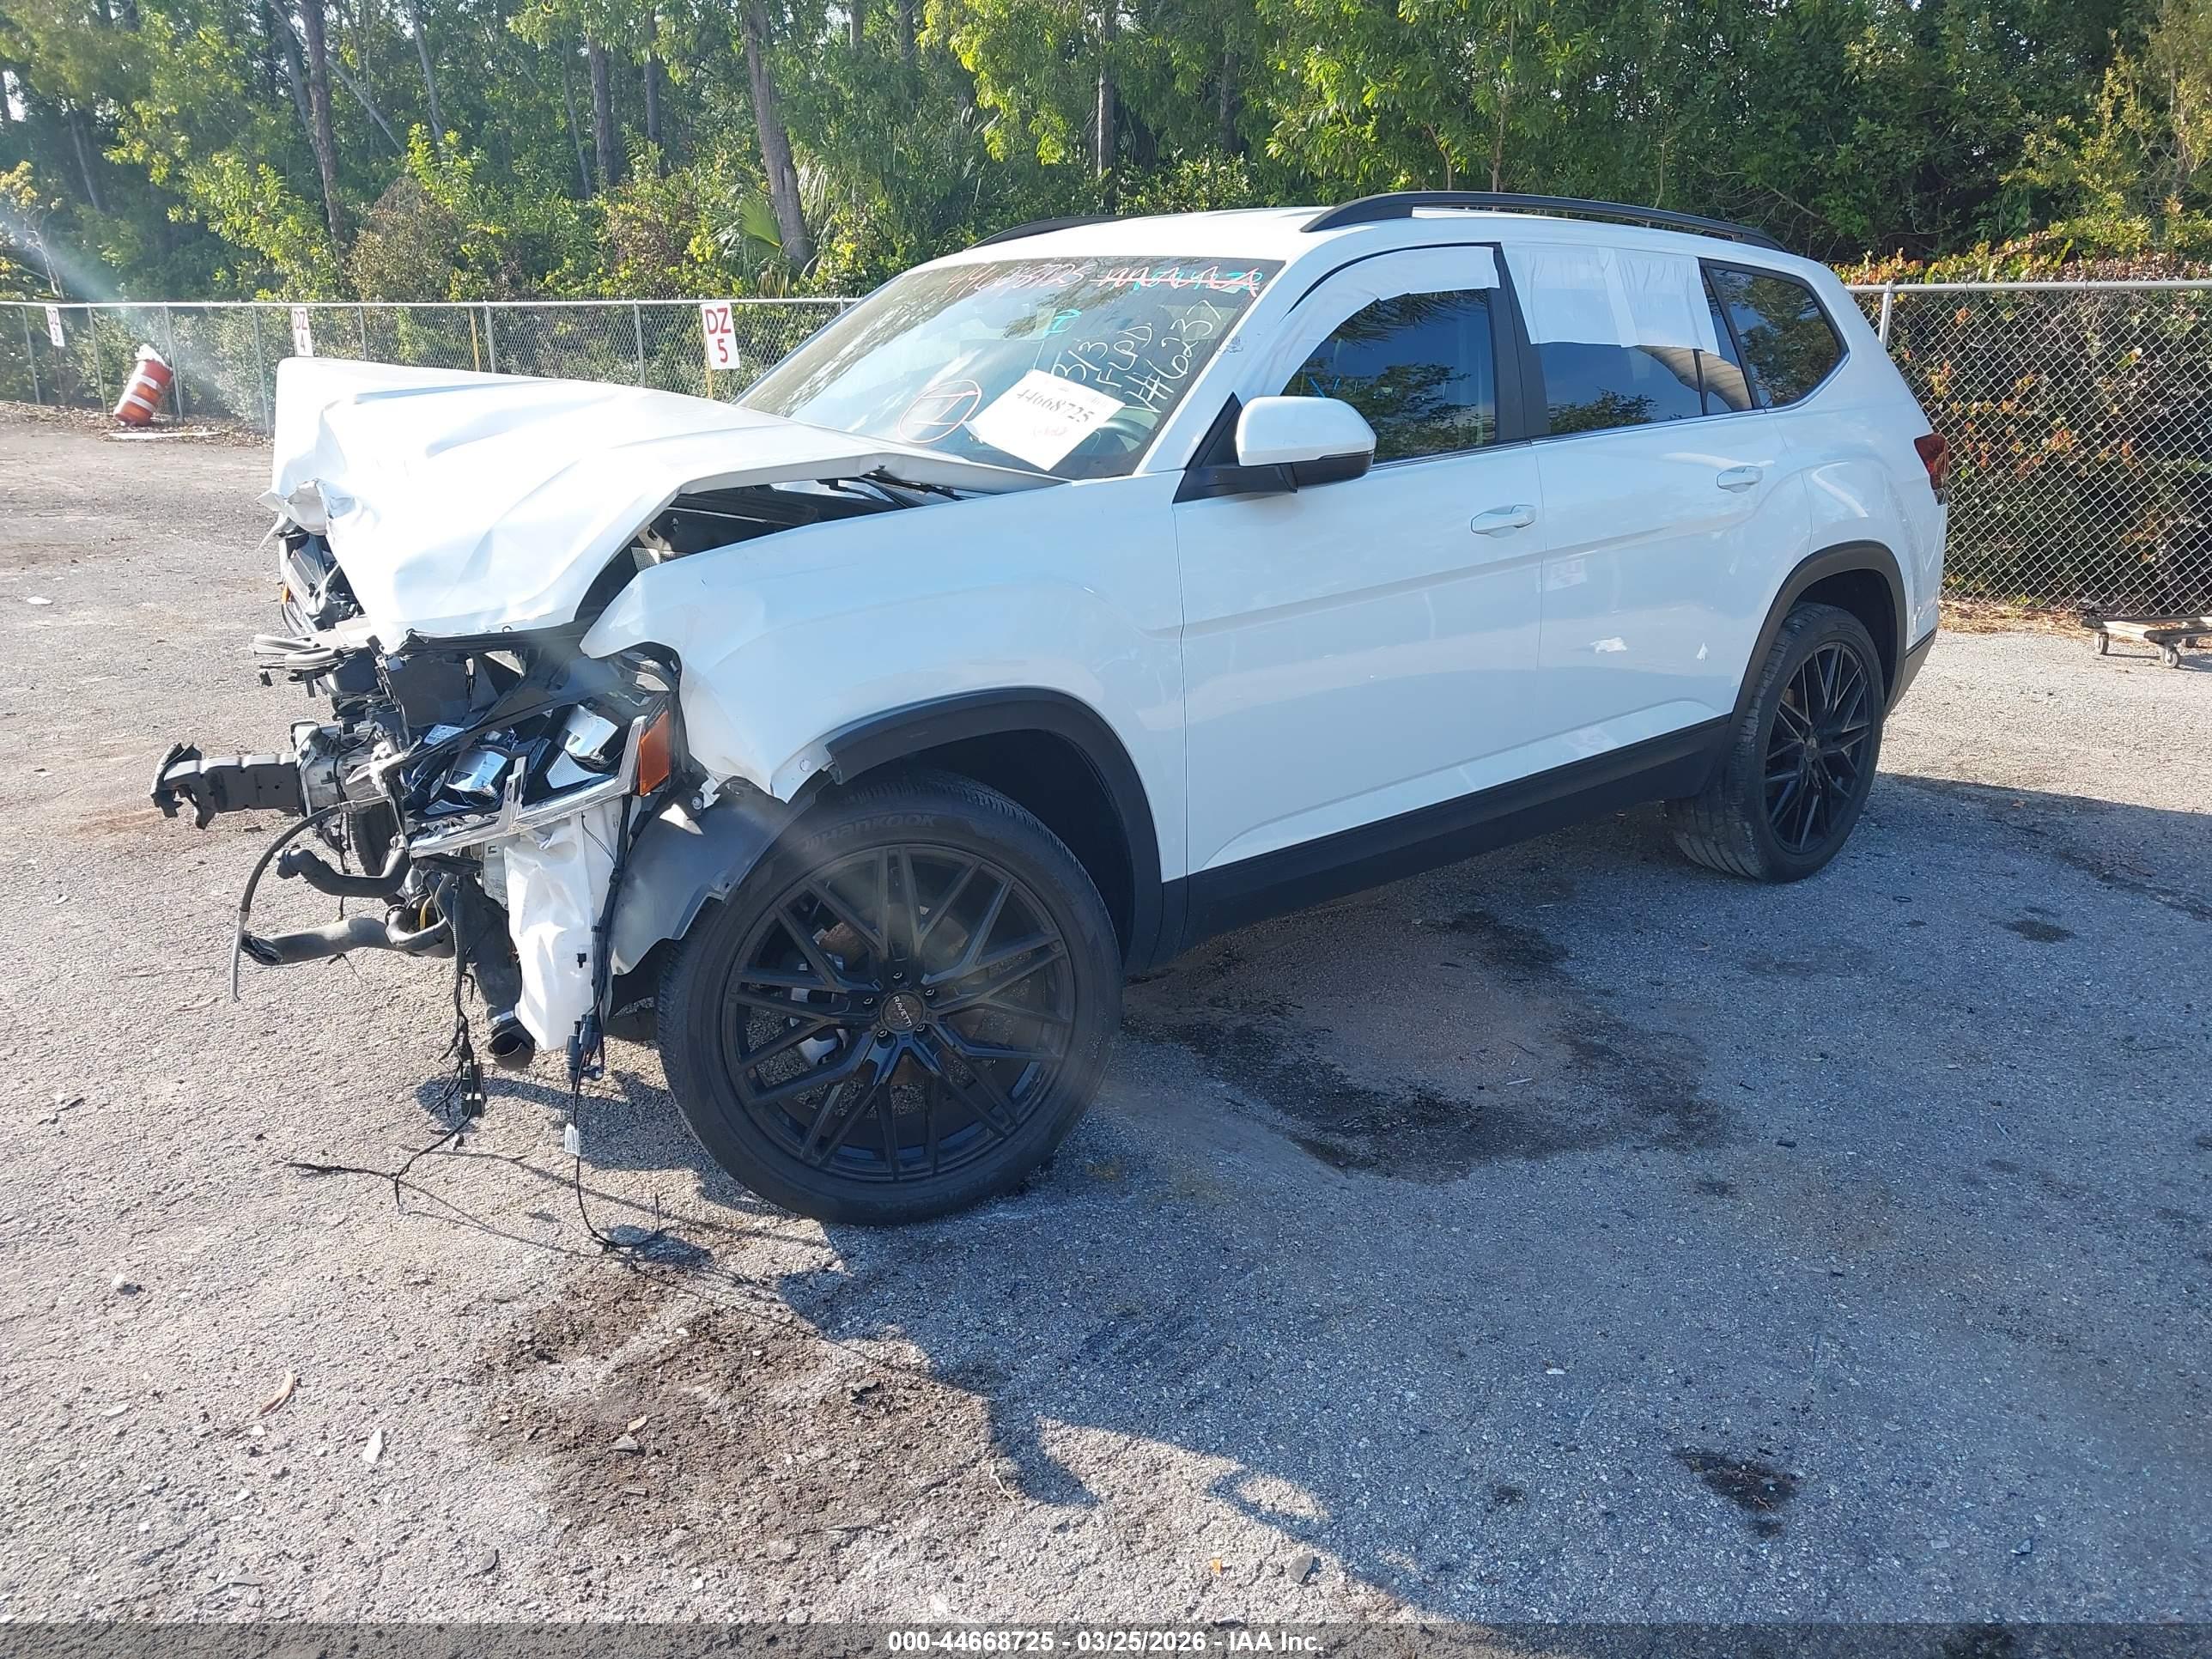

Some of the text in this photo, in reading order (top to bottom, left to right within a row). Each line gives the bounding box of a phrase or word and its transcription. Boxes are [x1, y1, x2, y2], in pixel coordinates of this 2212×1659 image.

[294, 311, 308, 331] DZ
[705, 307, 732, 335] DZ
[301, 332, 306, 351] 4
[717, 338, 729, 363] 5
[892, 995, 913, 1028] RAVETTI
